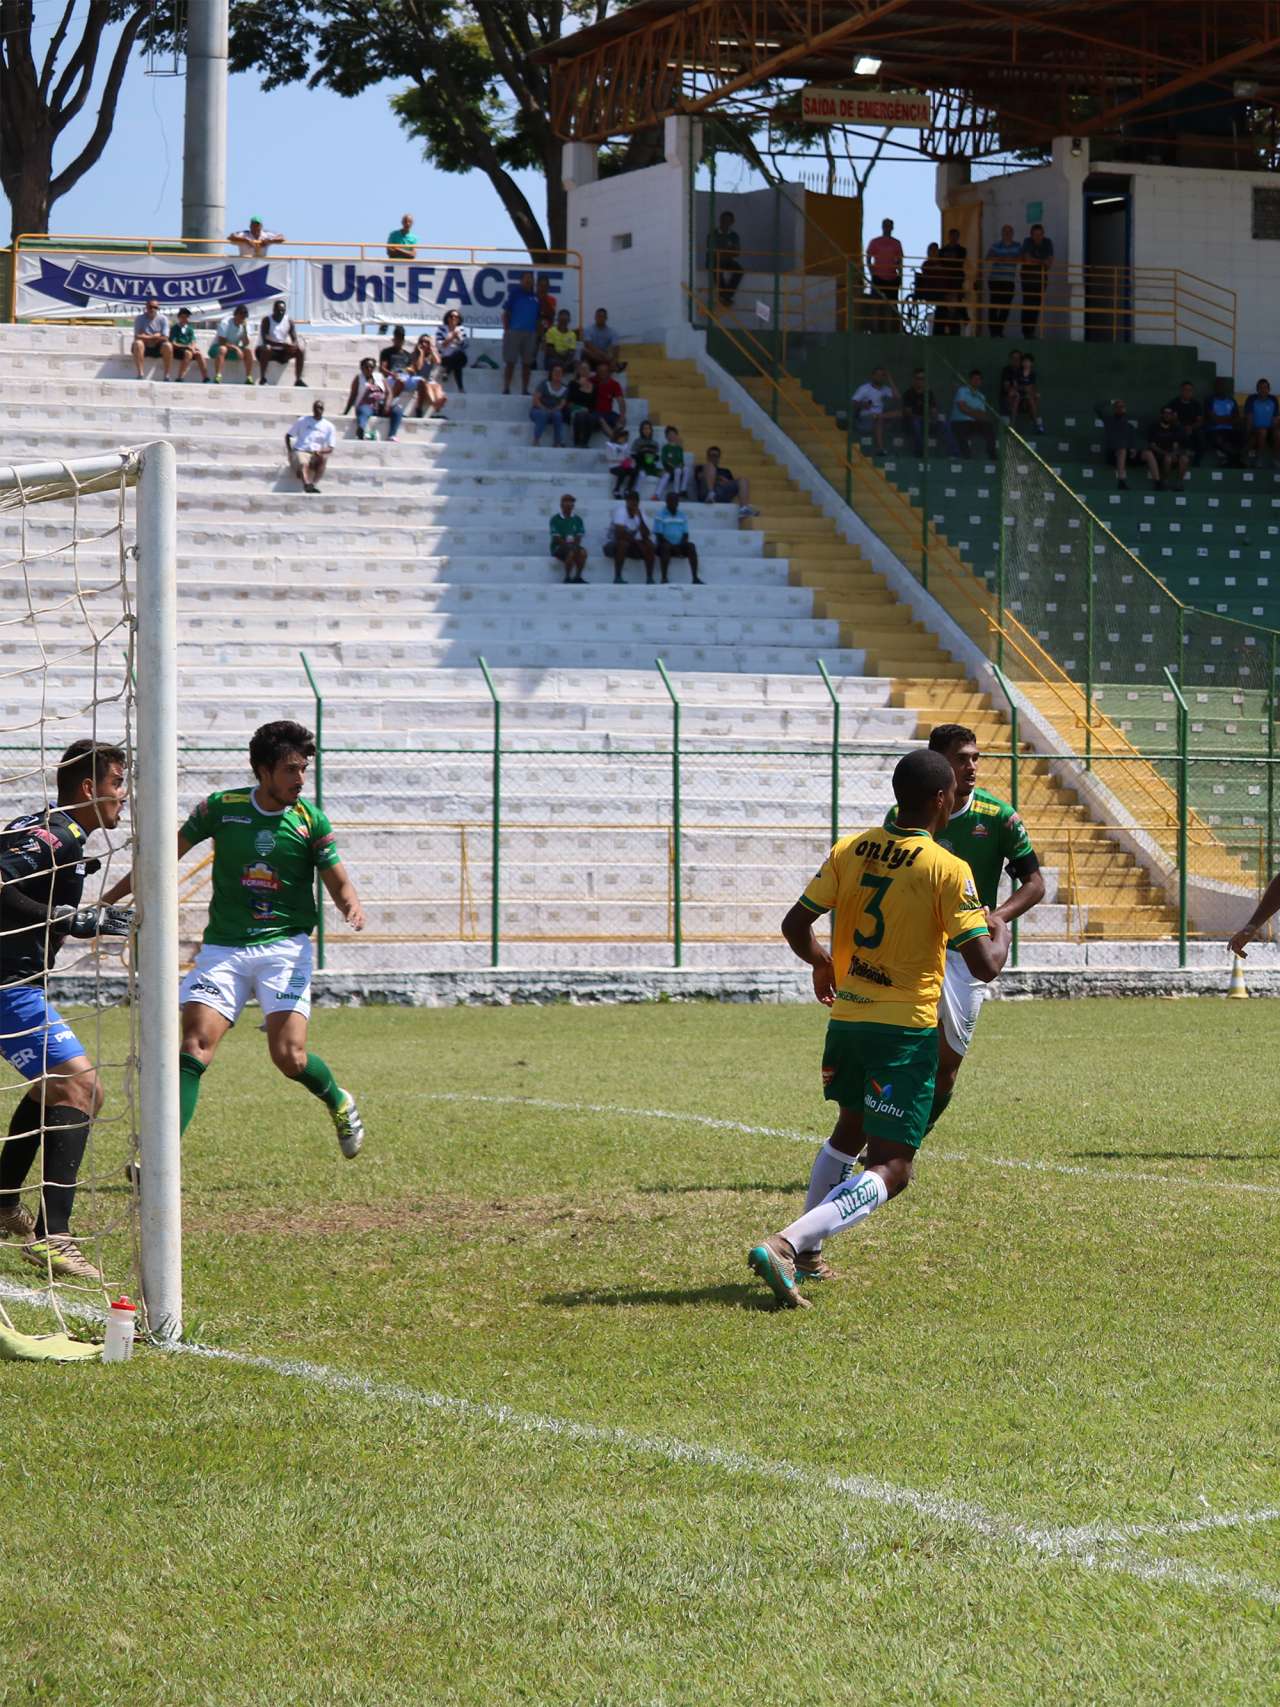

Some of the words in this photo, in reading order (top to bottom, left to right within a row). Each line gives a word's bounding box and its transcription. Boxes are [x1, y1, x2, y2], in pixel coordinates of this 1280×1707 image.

[839, 99, 854, 118] DE
[857, 98, 928, 122] EMERGÊNCIA
[82, 271, 157, 298] SANTA
[163, 274, 228, 298] CRUZ
[854, 840, 924, 870] only!
[853, 872, 895, 950] 3
[874, 1100, 905, 1118] jahu
[832, 1178, 879, 1220] Nizam
